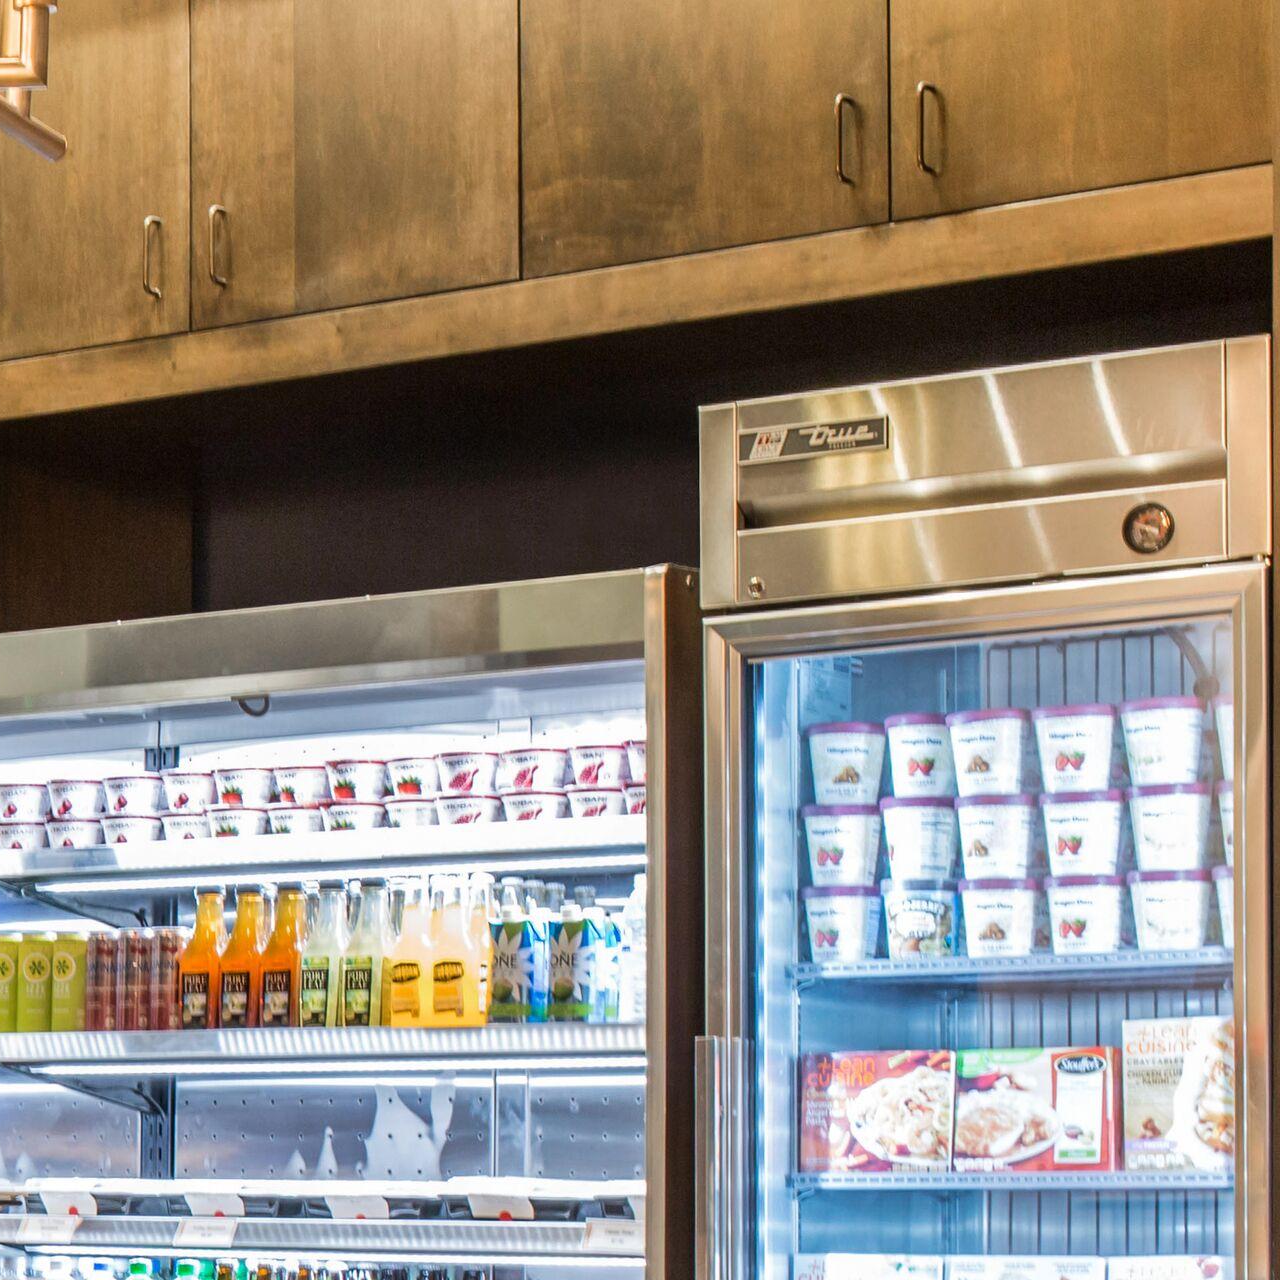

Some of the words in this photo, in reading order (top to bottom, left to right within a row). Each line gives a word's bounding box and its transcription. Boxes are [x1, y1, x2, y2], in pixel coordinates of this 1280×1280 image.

[183, 974, 207, 984] PURE
[224, 974, 247, 984] PURE
[265, 973, 289, 983] PURE
[303, 970, 326, 980] PURE
[346, 970, 370, 980] PURE
[183, 984, 207, 993] LEAF
[224, 984, 247, 993] LEAF
[265, 983, 289, 992] LEAF
[303, 980, 326, 989] LEAF
[346, 980, 370, 989] LEAF
[1126, 1040, 1197, 1056] cuisine
